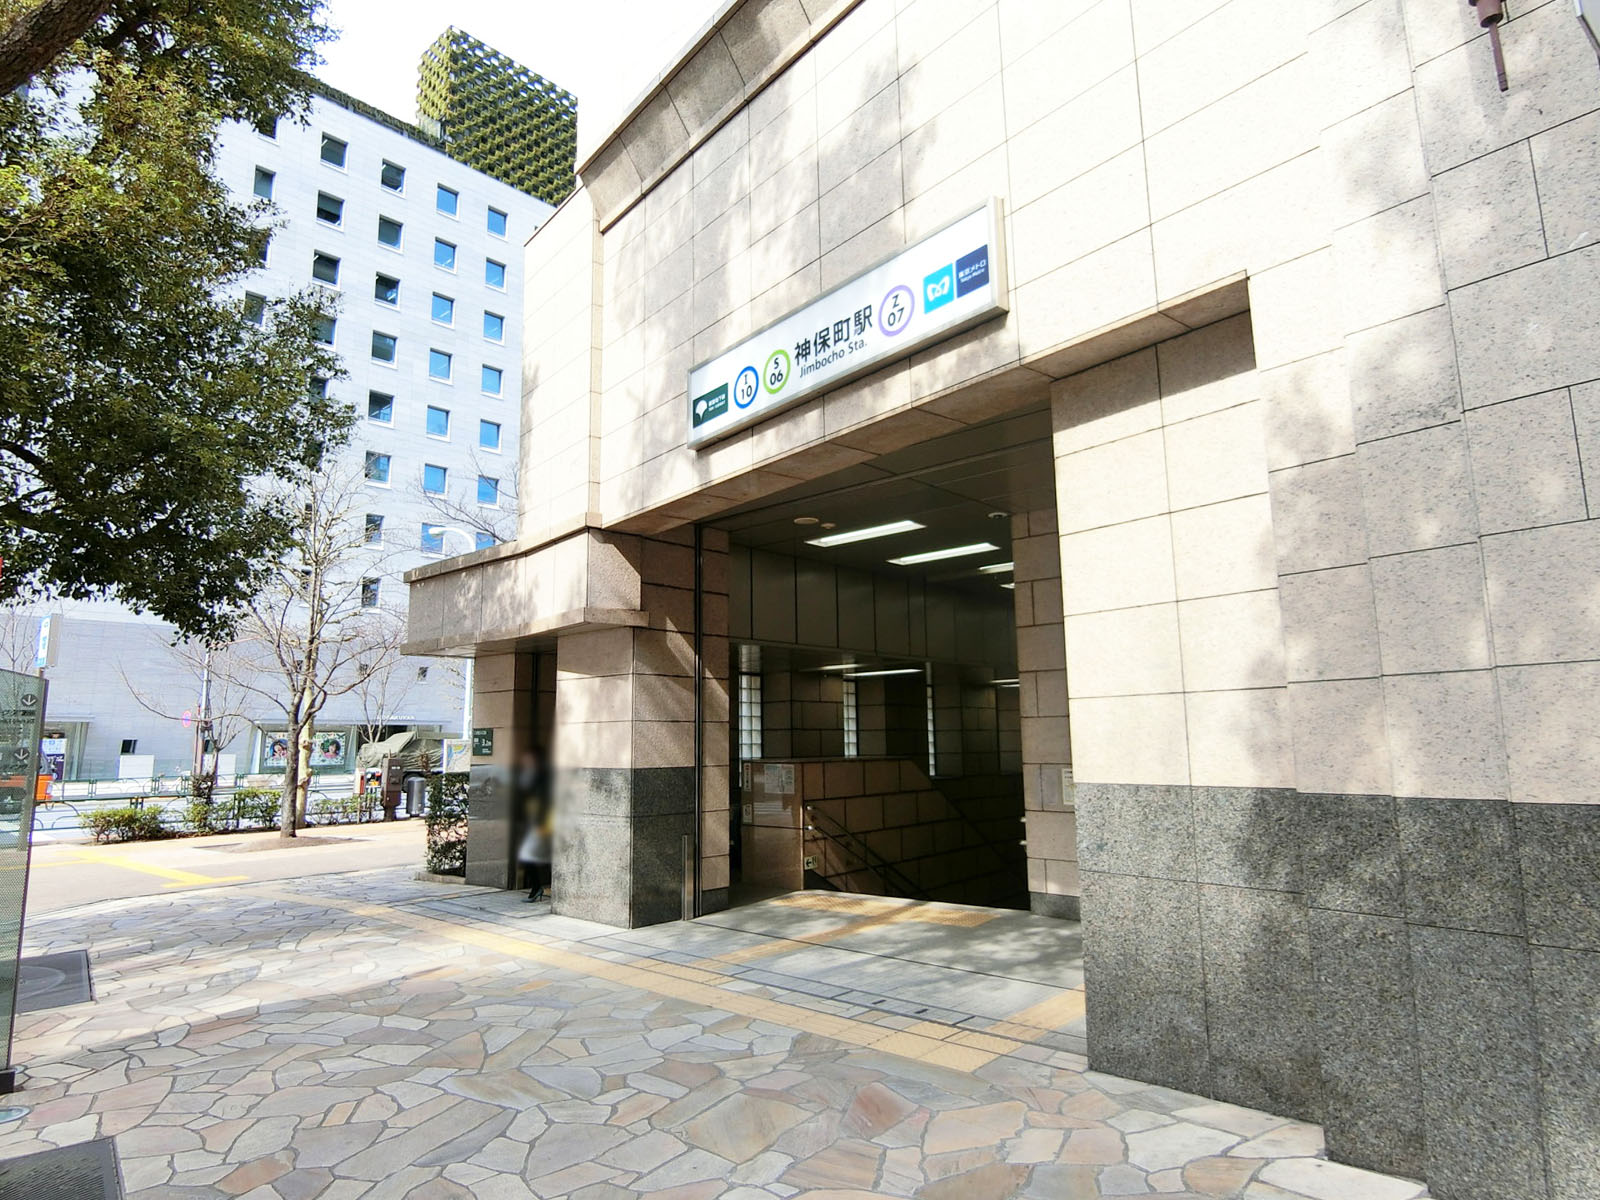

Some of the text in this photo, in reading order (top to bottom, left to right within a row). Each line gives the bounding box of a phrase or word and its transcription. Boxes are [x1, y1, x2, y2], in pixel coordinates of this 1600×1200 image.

[892, 294, 900, 309] Z
[887, 307, 905, 327] 07
[794, 304, 873, 366] 神保町駅
[774, 357, 780, 370] S
[799, 339, 868, 378] Jimbocho Sta.
[769, 370, 783, 386] 06
[741, 385, 753, 400] 10
